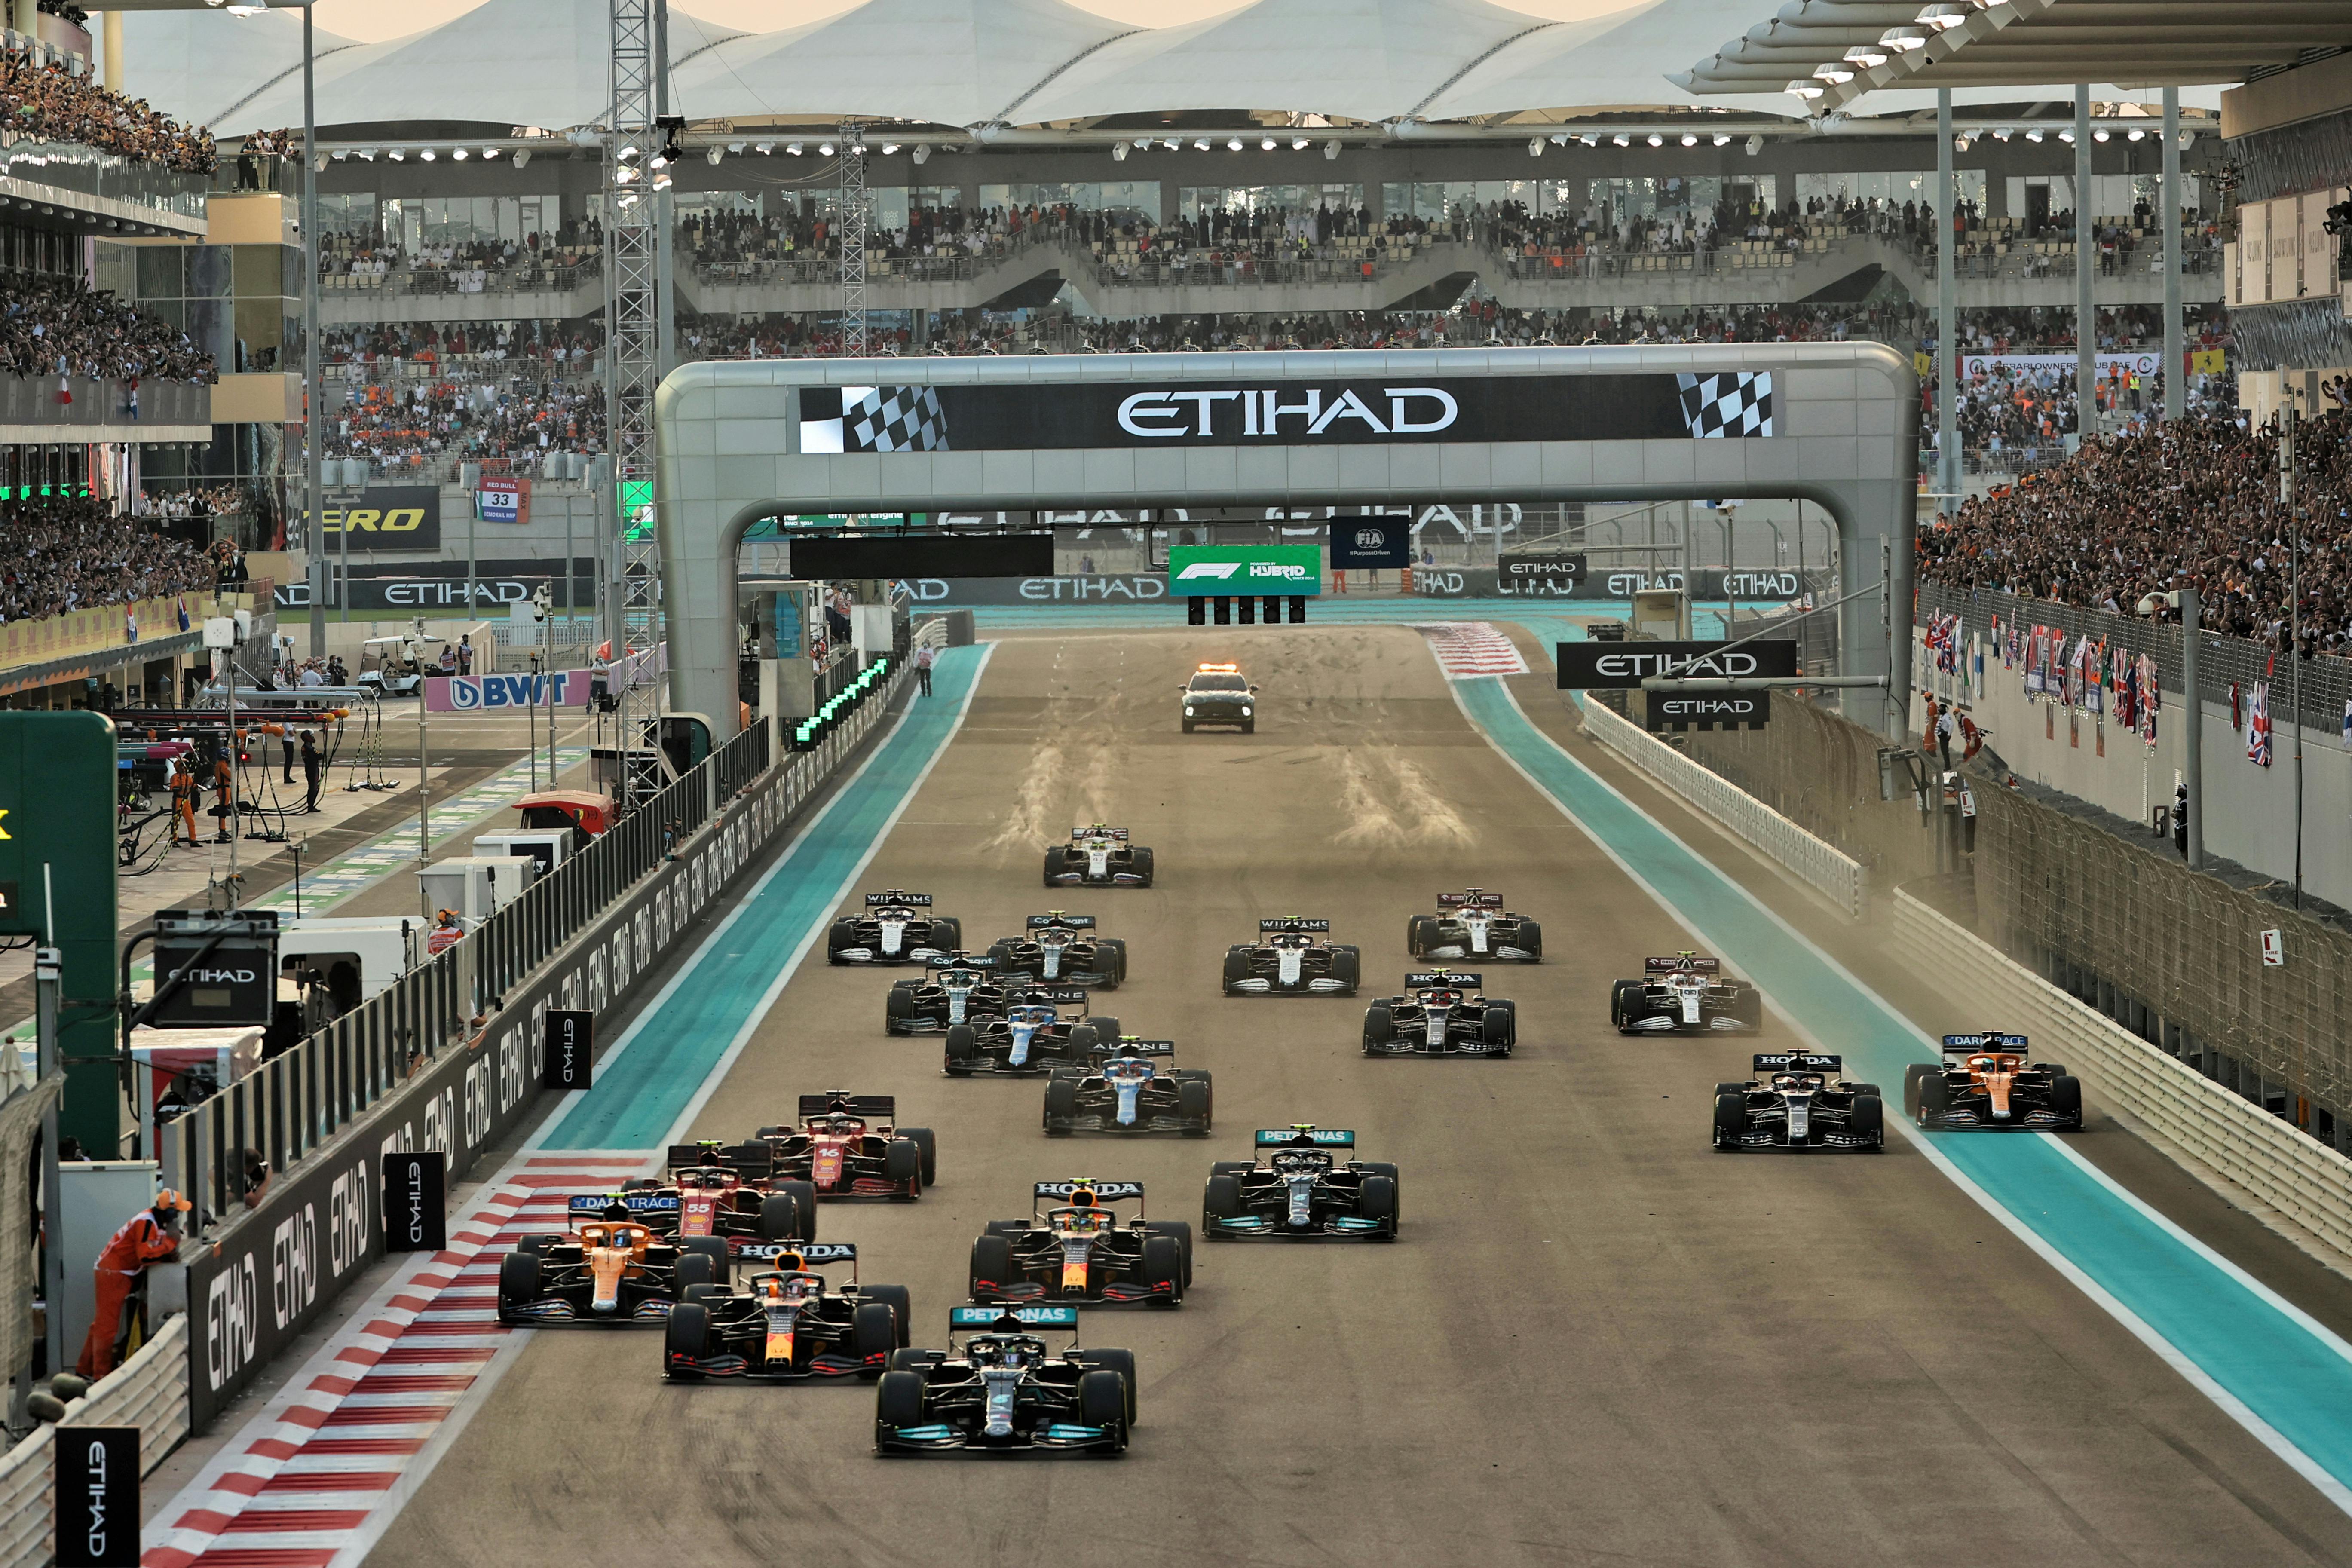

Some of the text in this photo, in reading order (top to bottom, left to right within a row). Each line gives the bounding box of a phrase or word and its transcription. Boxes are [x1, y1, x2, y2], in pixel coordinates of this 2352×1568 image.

[1118, 388, 1458, 436] ETIHAD
[491, 493, 509, 505] 33
[303, 509, 425, 532] ERO
[1250, 566, 1305, 580] HYBRID
[1510, 563, 1576, 573] ETIHAD
[385, 582, 527, 603] ETIHAD
[1019, 578, 1164, 599] ETIHAD
[1723, 574, 1797, 595] ETIHAD
[1596, 654, 1757, 676] ETIHAD
[483, 674, 566, 706] BWT
[1663, 700, 1753, 714] ETIHAD
[867, 895, 931, 903] WILAMS
[634, 903, 650, 974] ETIHAD
[613, 922, 629, 996] ETIHAD
[588, 943, 607, 1018] ETIHAD
[564, 1019, 573, 1083] ETIHAD
[1955, 1036, 2024, 1045] DARKRACE
[500, 1021, 524, 1114] ETIHAD
[466, 1052, 491, 1149] ETIHAD
[819, 1148, 839, 1157] 16
[408, 1162, 421, 1243] ETIHAD
[586, 1197, 677, 1208] DATRACE
[686, 1204, 710, 1213] 55
[330, 1160, 368, 1277] ETIHAD
[273, 1204, 316, 1330] ETIHAD
[208, 1252, 256, 1391] ETIHAD
[963, 1308, 1066, 1321] PETONAS
[89, 1441, 106, 1557] ETIHAD
